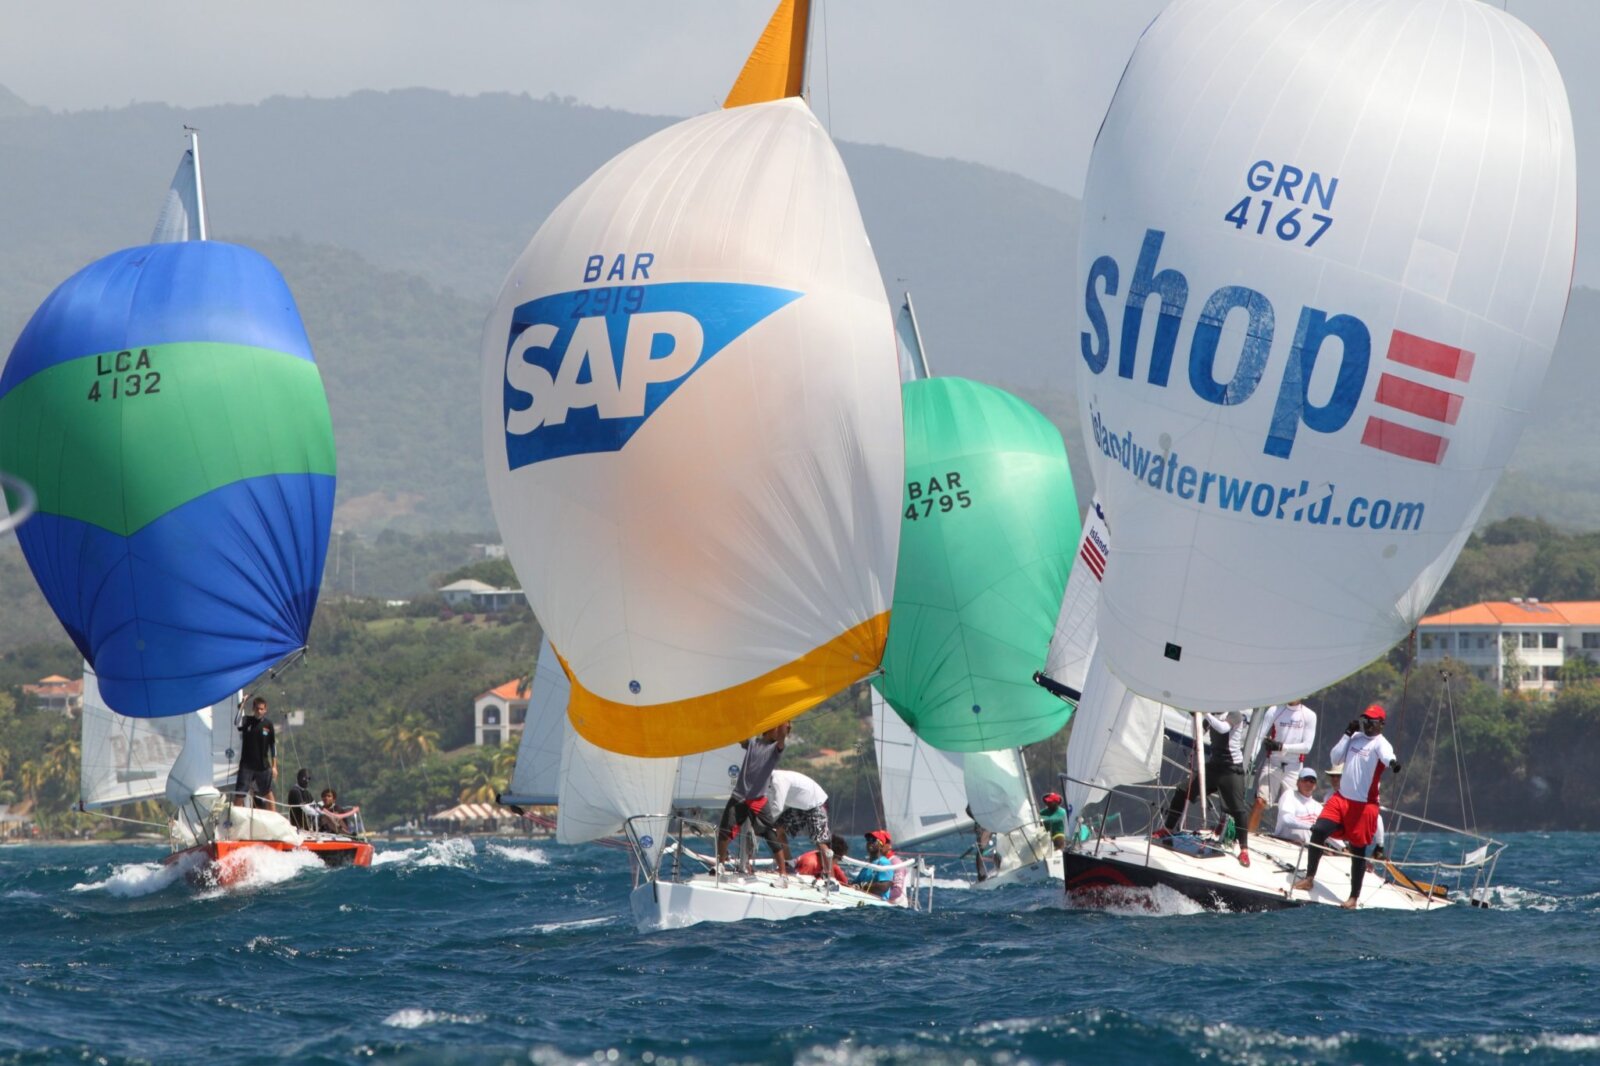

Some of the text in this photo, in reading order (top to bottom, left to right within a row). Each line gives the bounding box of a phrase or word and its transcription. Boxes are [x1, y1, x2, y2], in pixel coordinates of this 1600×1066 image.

[1246, 159, 1339, 211] GRN
[1223, 196, 1334, 248] 4167
[583, 253, 655, 283] BAR
[571, 286, 645, 318] 2919
[1080, 228, 1372, 460] shop
[97, 349, 151, 376] LCA
[506, 311, 704, 435] SAP
[88, 372, 161, 402] 4132
[908, 472, 962, 500] BAR
[904, 490, 971, 521] 4795
